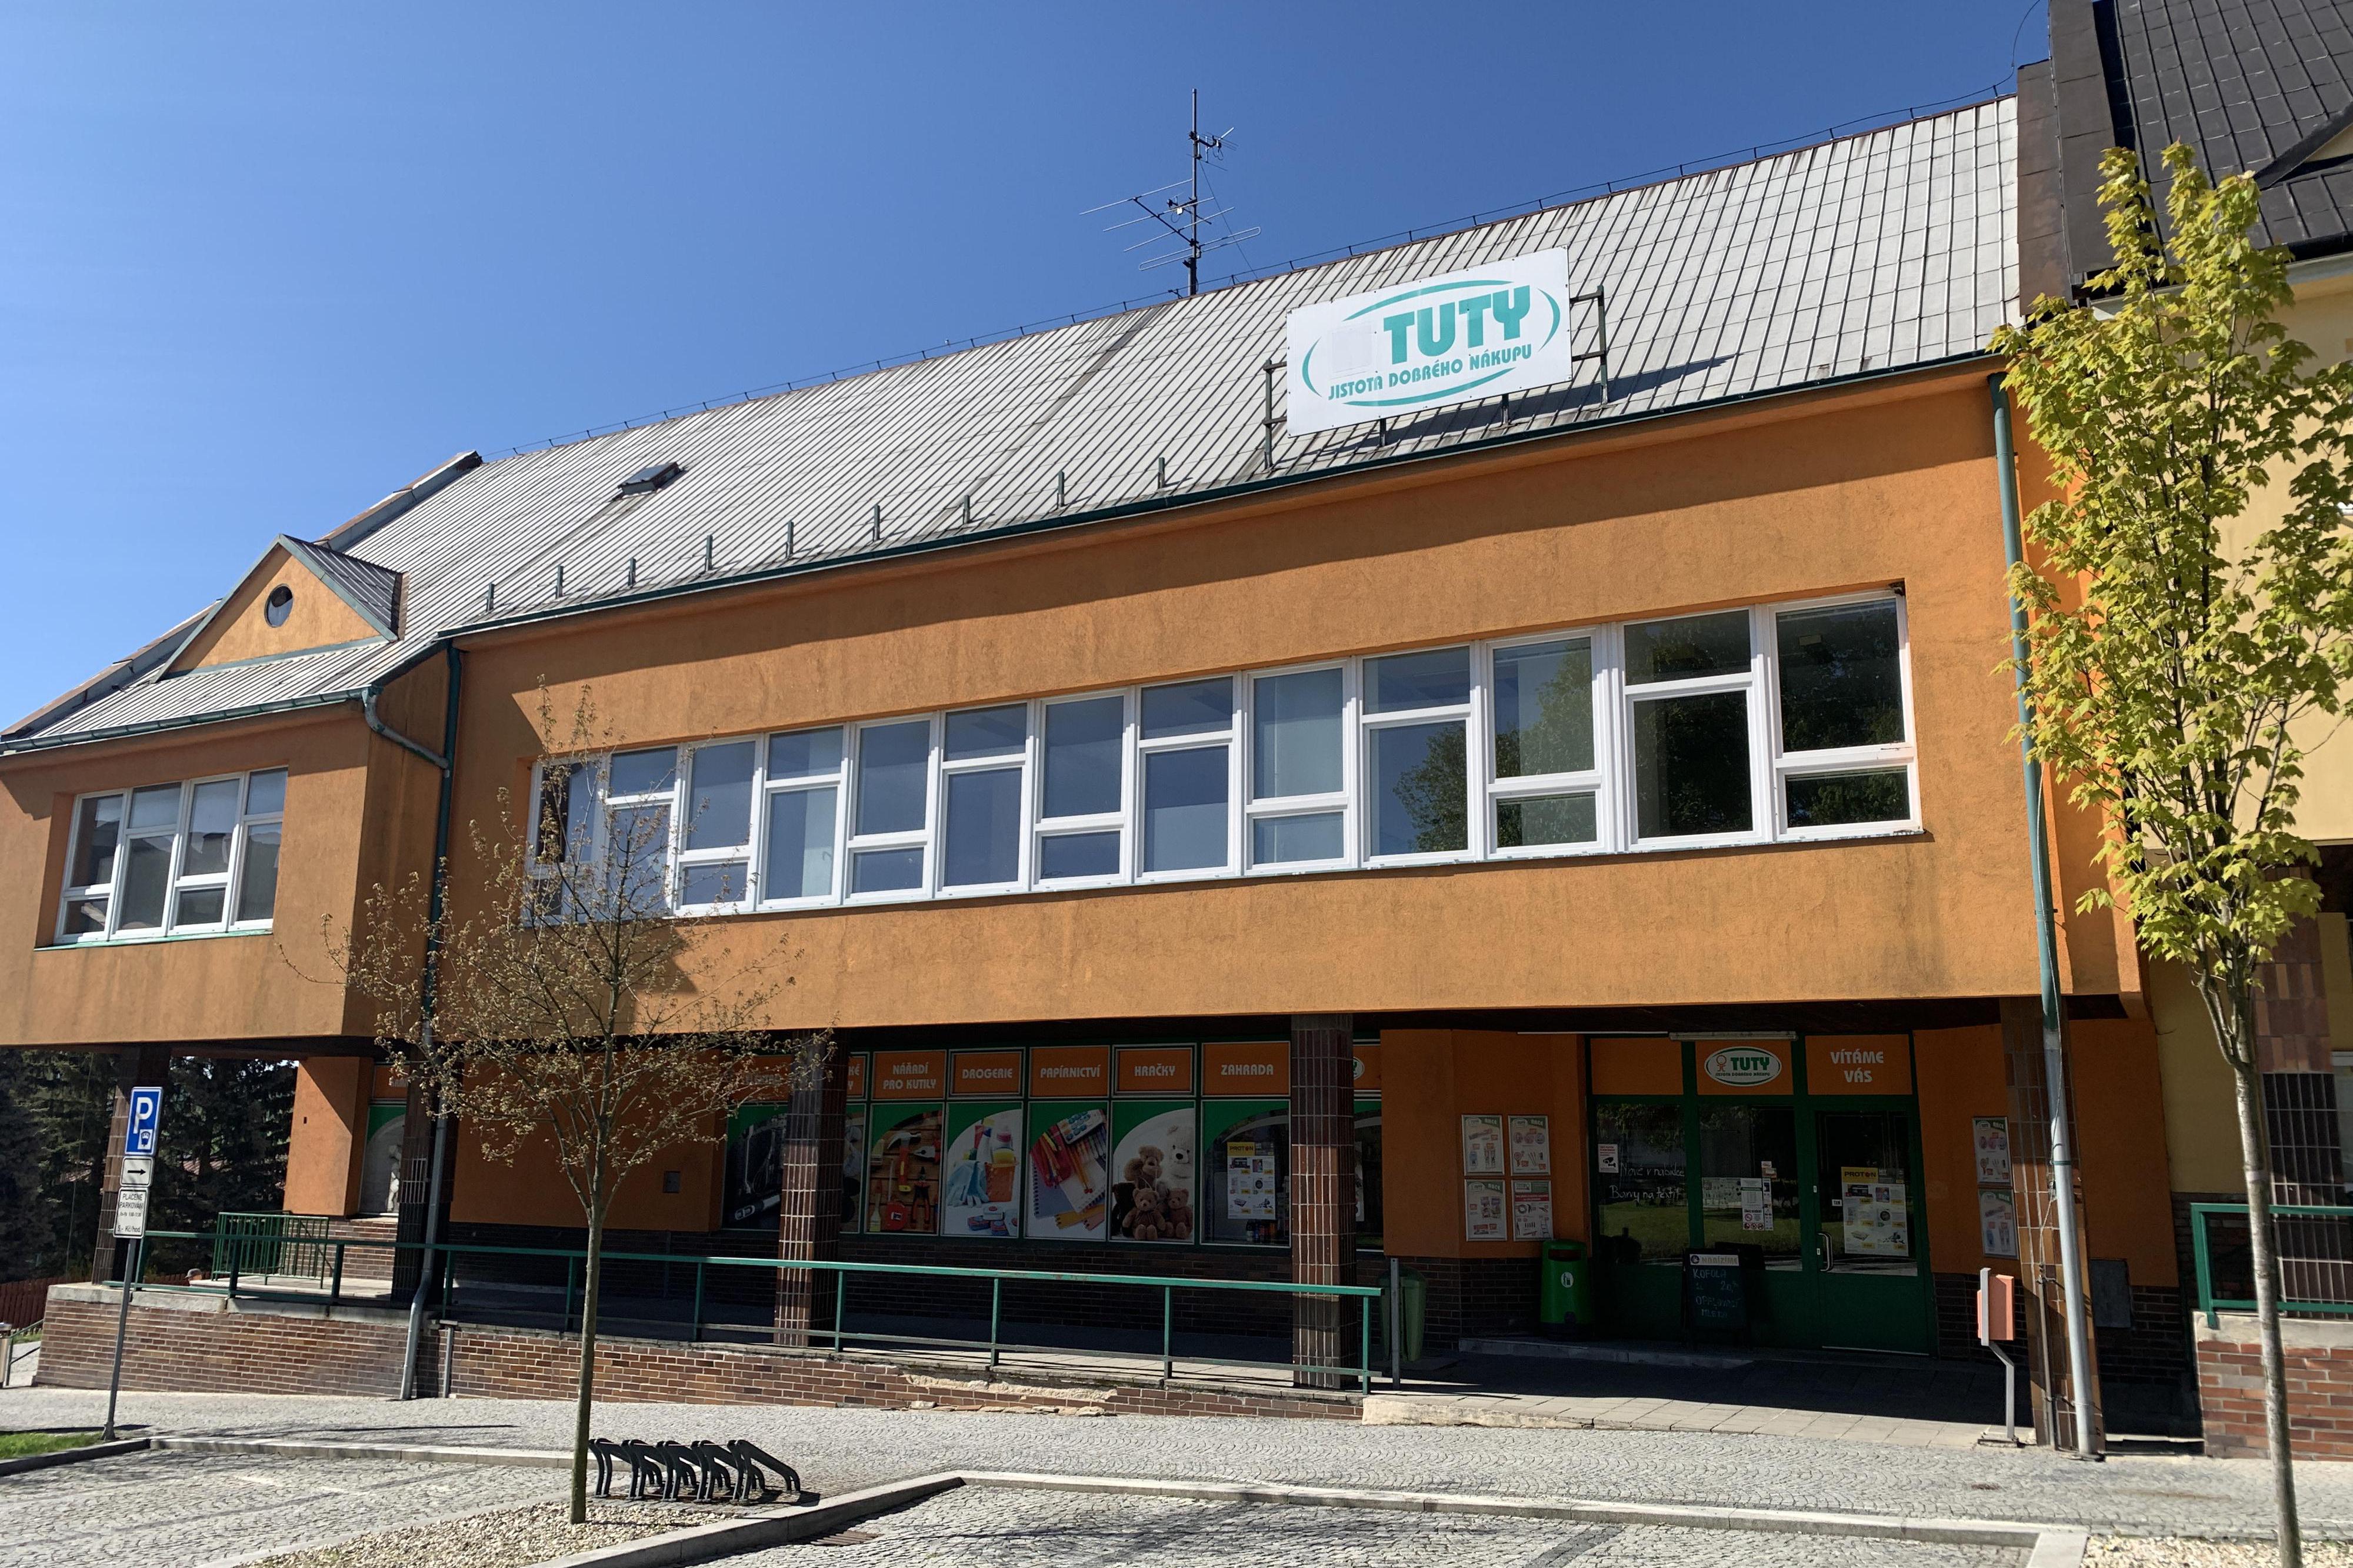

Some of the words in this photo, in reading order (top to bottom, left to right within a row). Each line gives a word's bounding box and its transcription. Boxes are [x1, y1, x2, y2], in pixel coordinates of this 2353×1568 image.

[1383, 285, 1530, 365] TUTY
[1328, 371, 1383, 401] JISTOTA
[1388, 359, 1463, 388] DOBRÉHO
[1469, 343, 1531, 370] NÁKUPU
[1830, 1048, 1884, 1064] VÍTÁME
[892, 1062, 928, 1075] NÁŘADÍ
[1134, 1063, 1176, 1076] HRAČKY
[1220, 1064, 1274, 1076] ZAHRADA
[1730, 1057, 1769, 1070] TUTY
[962, 1068, 1013, 1079] DROGERIE
[1040, 1064, 1101, 1077] PAPÍRNICTVÍ
[1844, 1067, 1873, 1083] VÁS
[883, 1079, 903, 1089] PRO
[906, 1079, 936, 1089] KUTILY
[133, 1096, 153, 1135] P
[1693, 1268, 1727, 1279] KOFOLA
